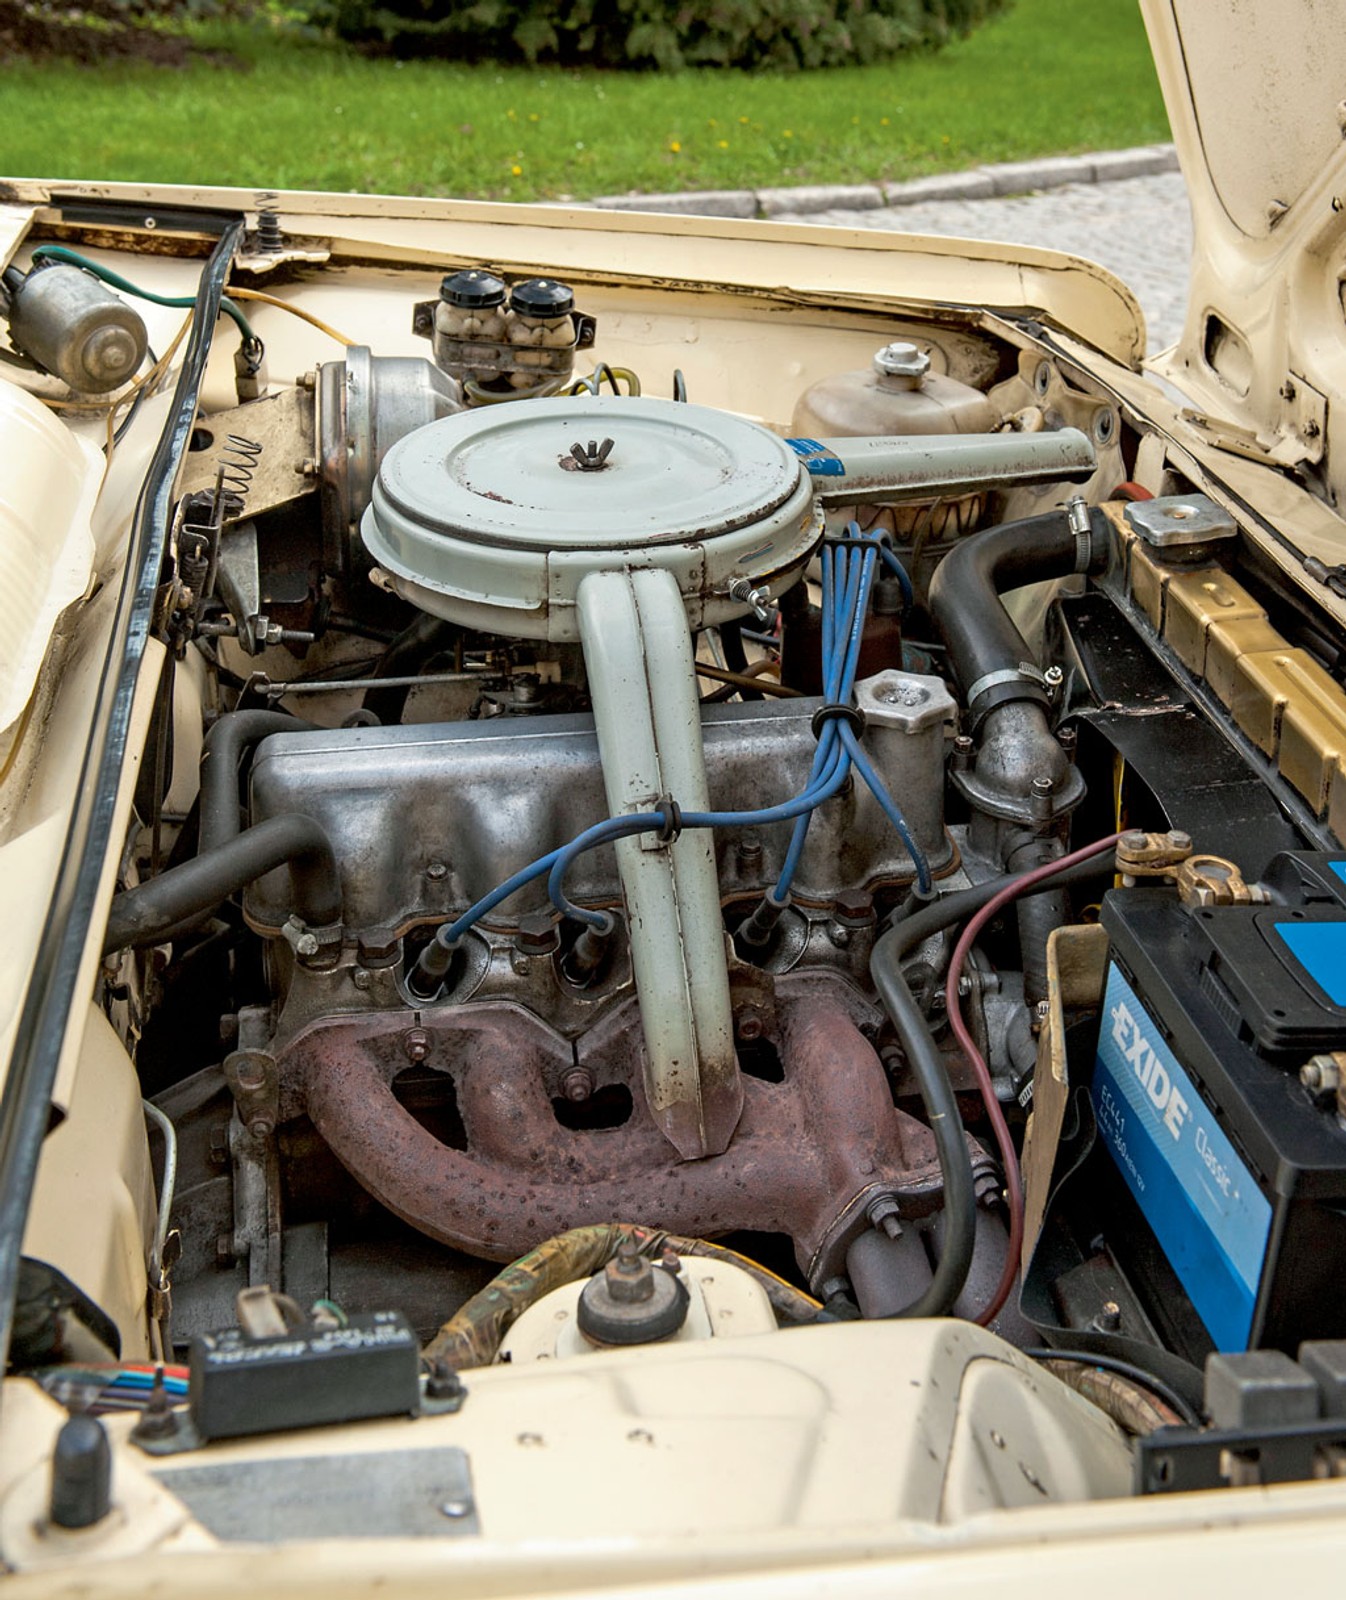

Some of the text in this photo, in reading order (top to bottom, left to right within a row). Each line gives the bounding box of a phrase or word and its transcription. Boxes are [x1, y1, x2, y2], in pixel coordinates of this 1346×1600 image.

[1101, 1085, 1125, 1134] EC441
[1111, 1002, 1230, 1197] EXIDE Classic
